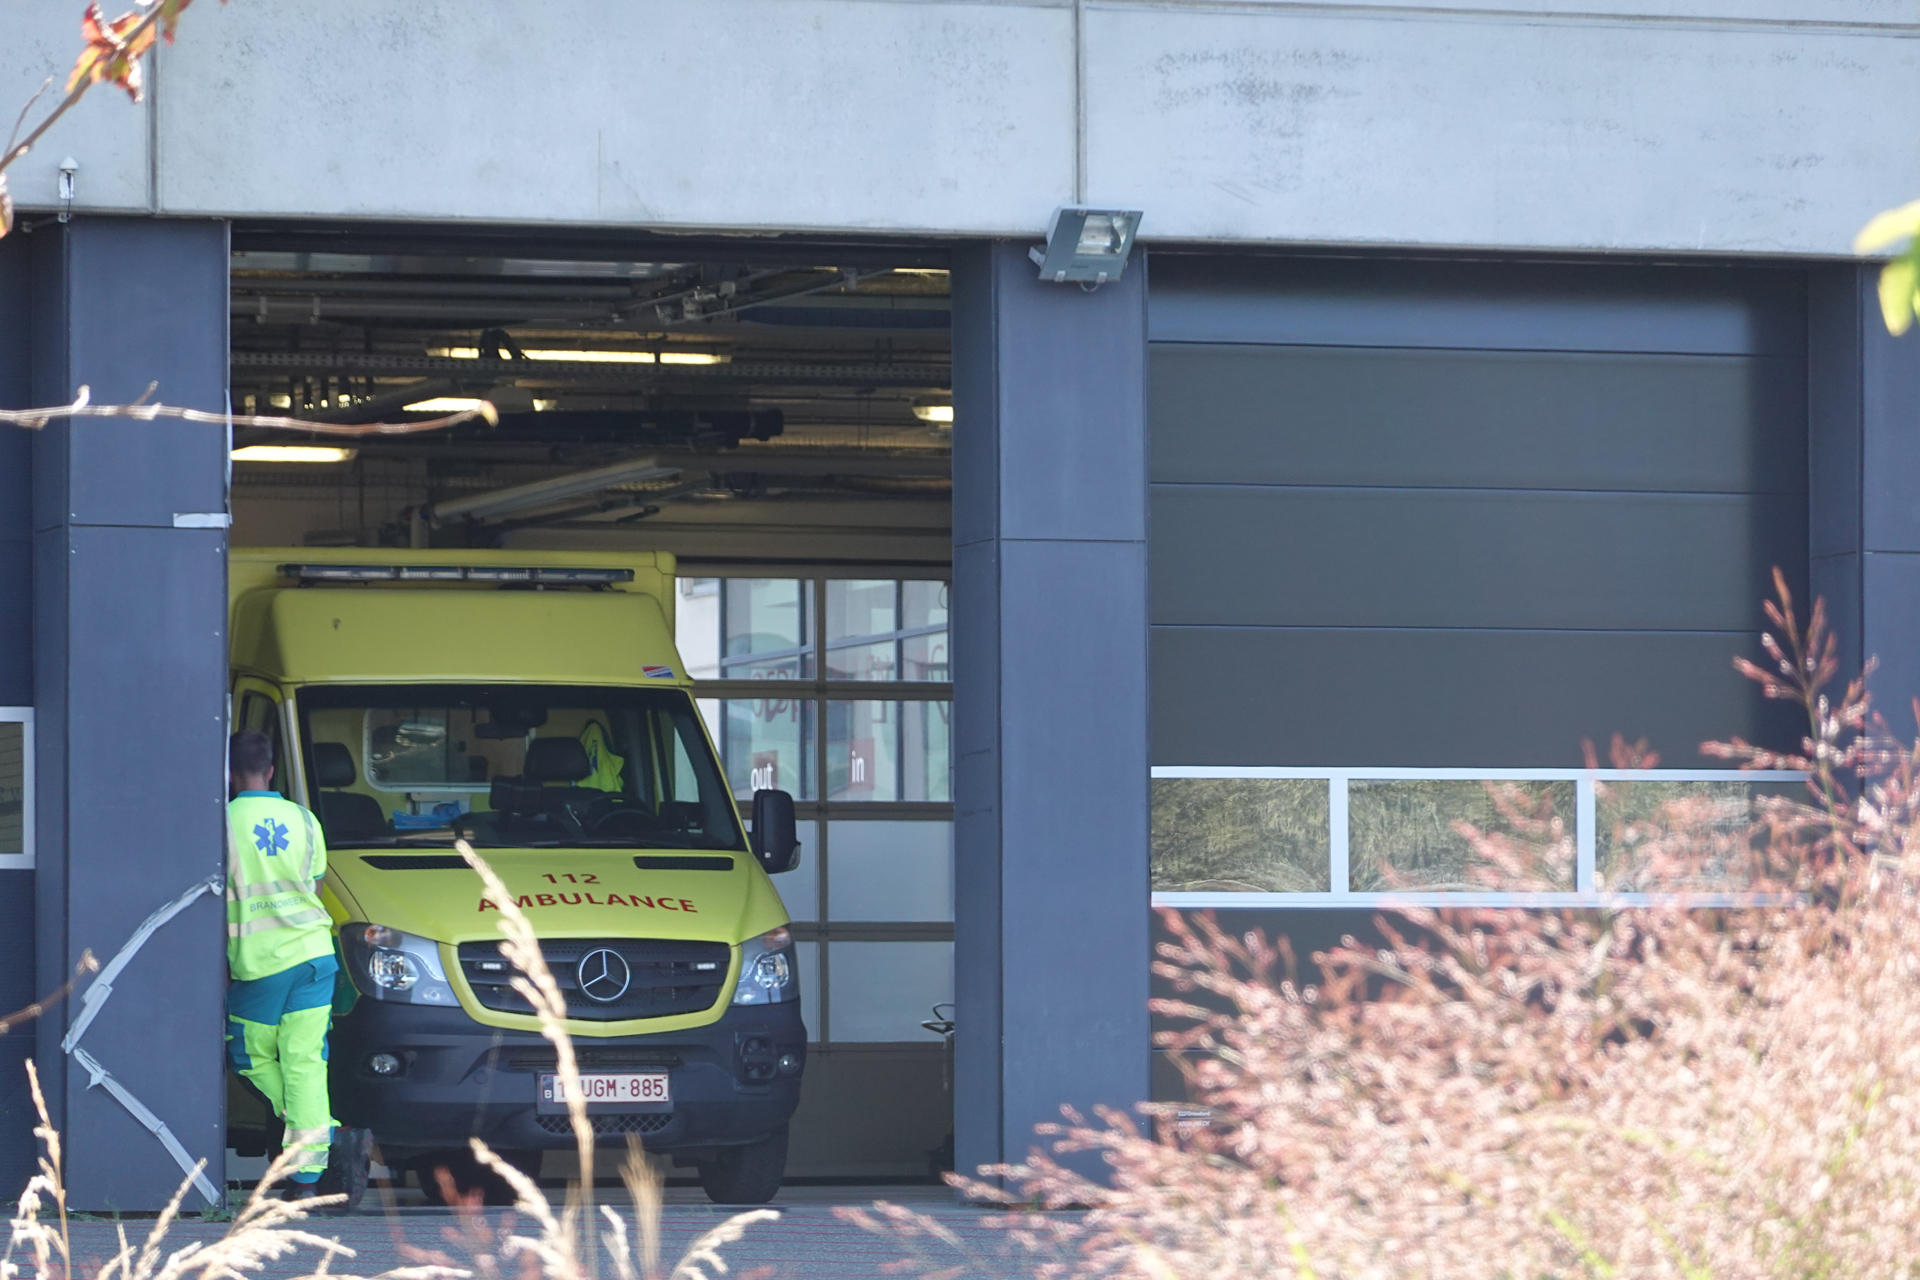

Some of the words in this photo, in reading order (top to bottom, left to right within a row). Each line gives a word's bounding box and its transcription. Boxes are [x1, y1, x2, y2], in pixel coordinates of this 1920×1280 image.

[851, 751, 865, 783] in
[750, 763, 774, 792] out
[541, 873, 601, 884] 112
[249, 896, 309, 913] BRANDWEER
[478, 892, 698, 913] AMBULANCE
[544, 1089, 552, 1099] B
[558, 1079, 664, 1098] 1UGM-885
